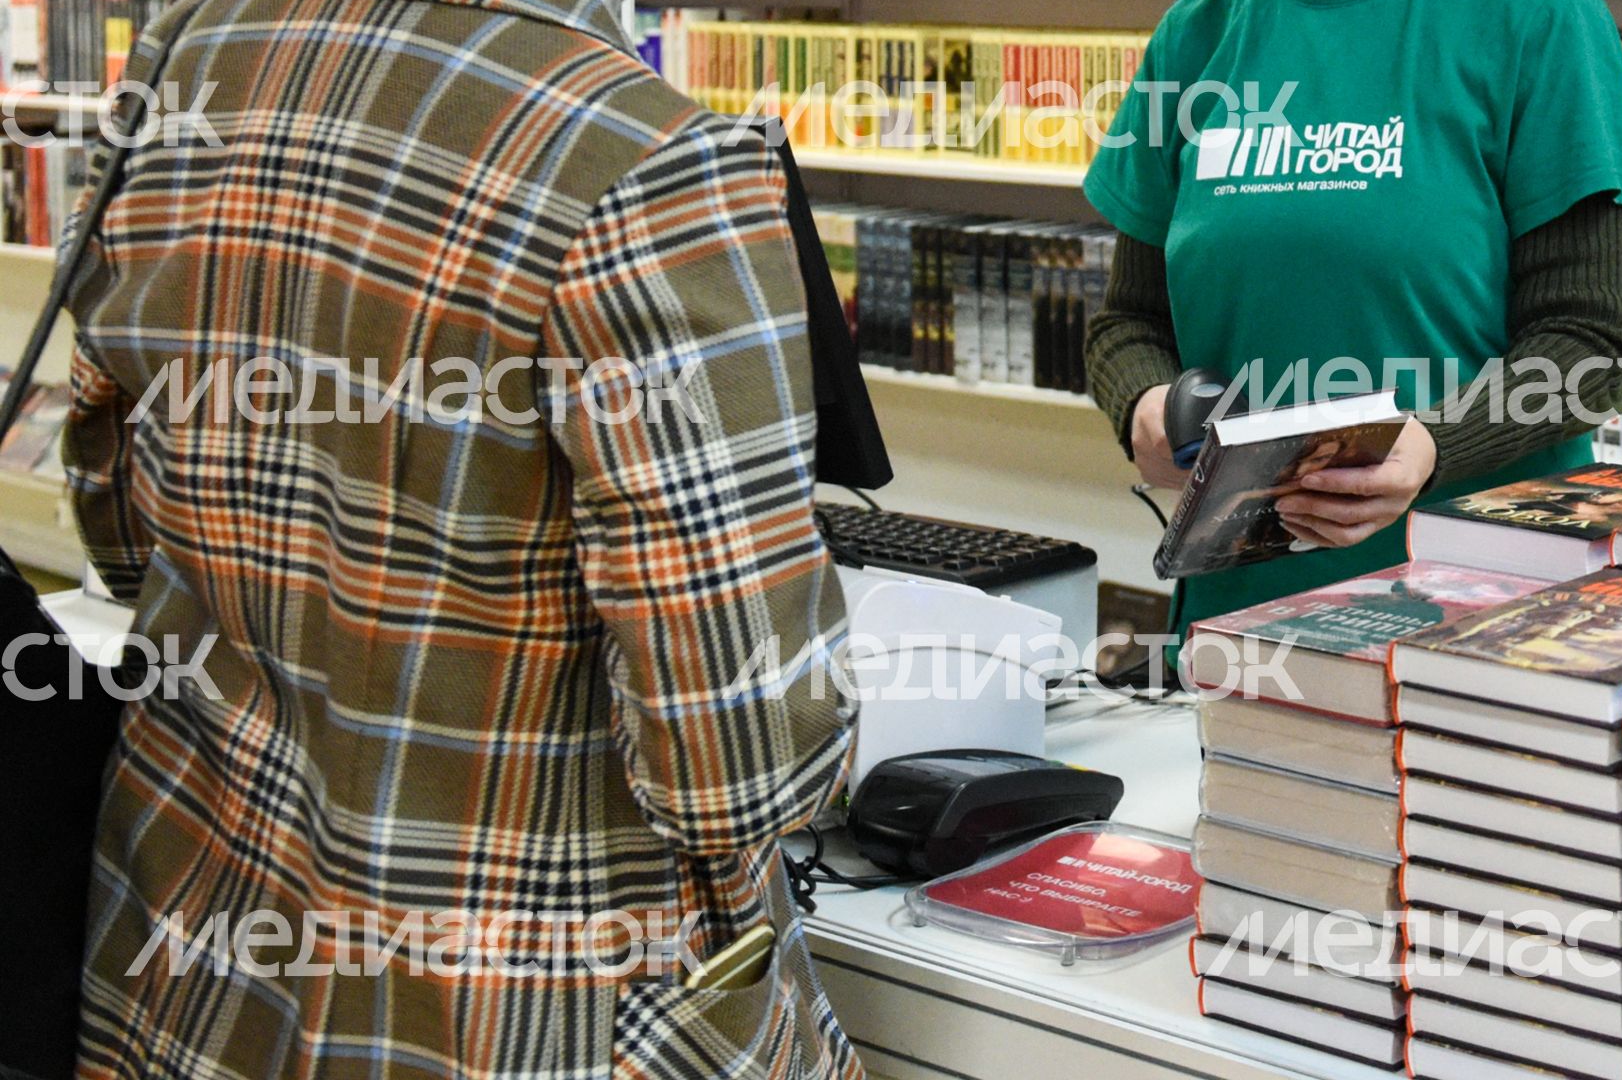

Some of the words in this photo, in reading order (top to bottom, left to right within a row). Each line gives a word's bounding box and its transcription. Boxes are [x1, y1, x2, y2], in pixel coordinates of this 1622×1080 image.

[1304, 115, 1404, 150] ЧИТАЙ
[1294, 147, 1403, 178] ГОРОД
[1213, 182, 1237, 197] сеть
[1239, 179, 1295, 194] книжных
[1297, 177, 1369, 192] магазинов
[1463, 497, 1592, 529] ТОБОЛ
[983, 887, 1020, 901] НАС
[1008, 880, 1041, 894] ЧТО
[1040, 888, 1143, 917] ВЫБИРАЕТЕ
